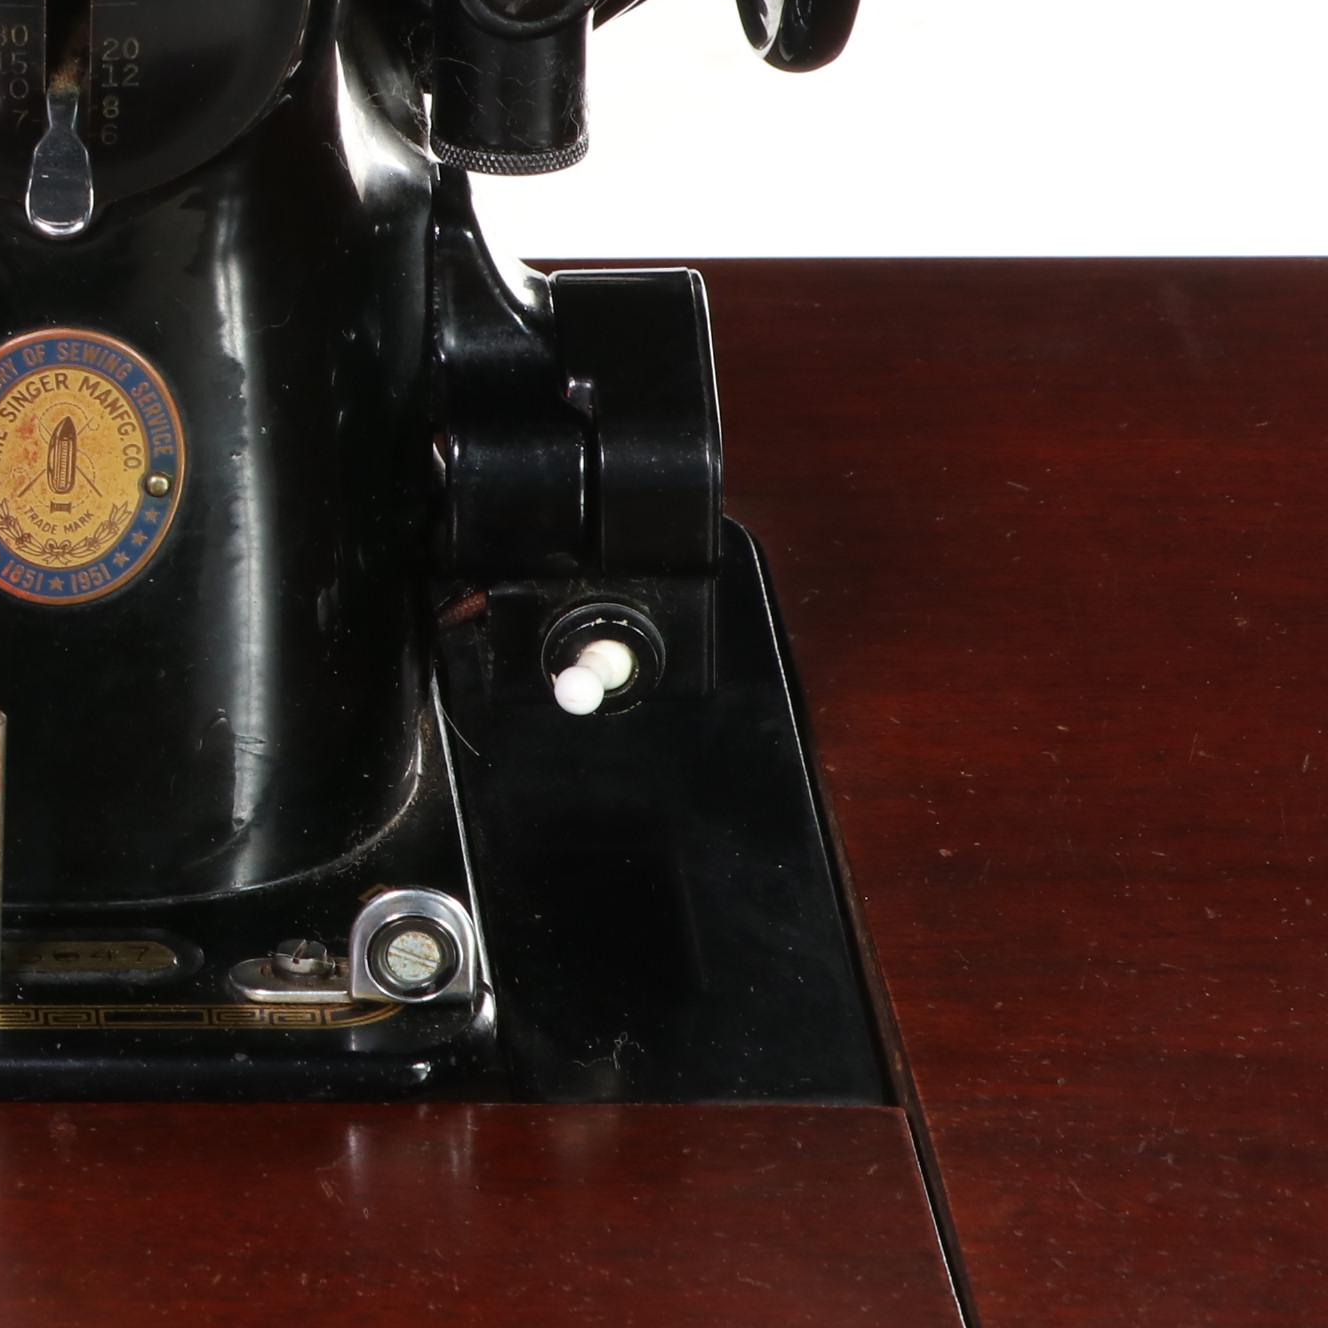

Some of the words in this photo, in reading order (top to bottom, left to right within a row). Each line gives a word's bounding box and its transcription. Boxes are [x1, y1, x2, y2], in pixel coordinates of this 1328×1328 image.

[101, 37, 140, 62] 20
[101, 63, 140, 88] 12
[101, 94, 120, 119] 8
[13, 108, 30, 132] 7
[100, 122, 120, 146] 6
[22, 344, 46, 366] OF
[55, 342, 134, 381] SEWING
[132, 381, 174, 456] SERVICE
[0, 372, 70, 424] SINGER
[78, 375, 136, 442] MANFG.
[122, 444, 142, 472] CO.
[23, 505, 57, 535] TRADE
[63, 509, 95, 535] MARK
[0, 559, 43, 592] 1851
[69, 563, 112, 594] 1951
